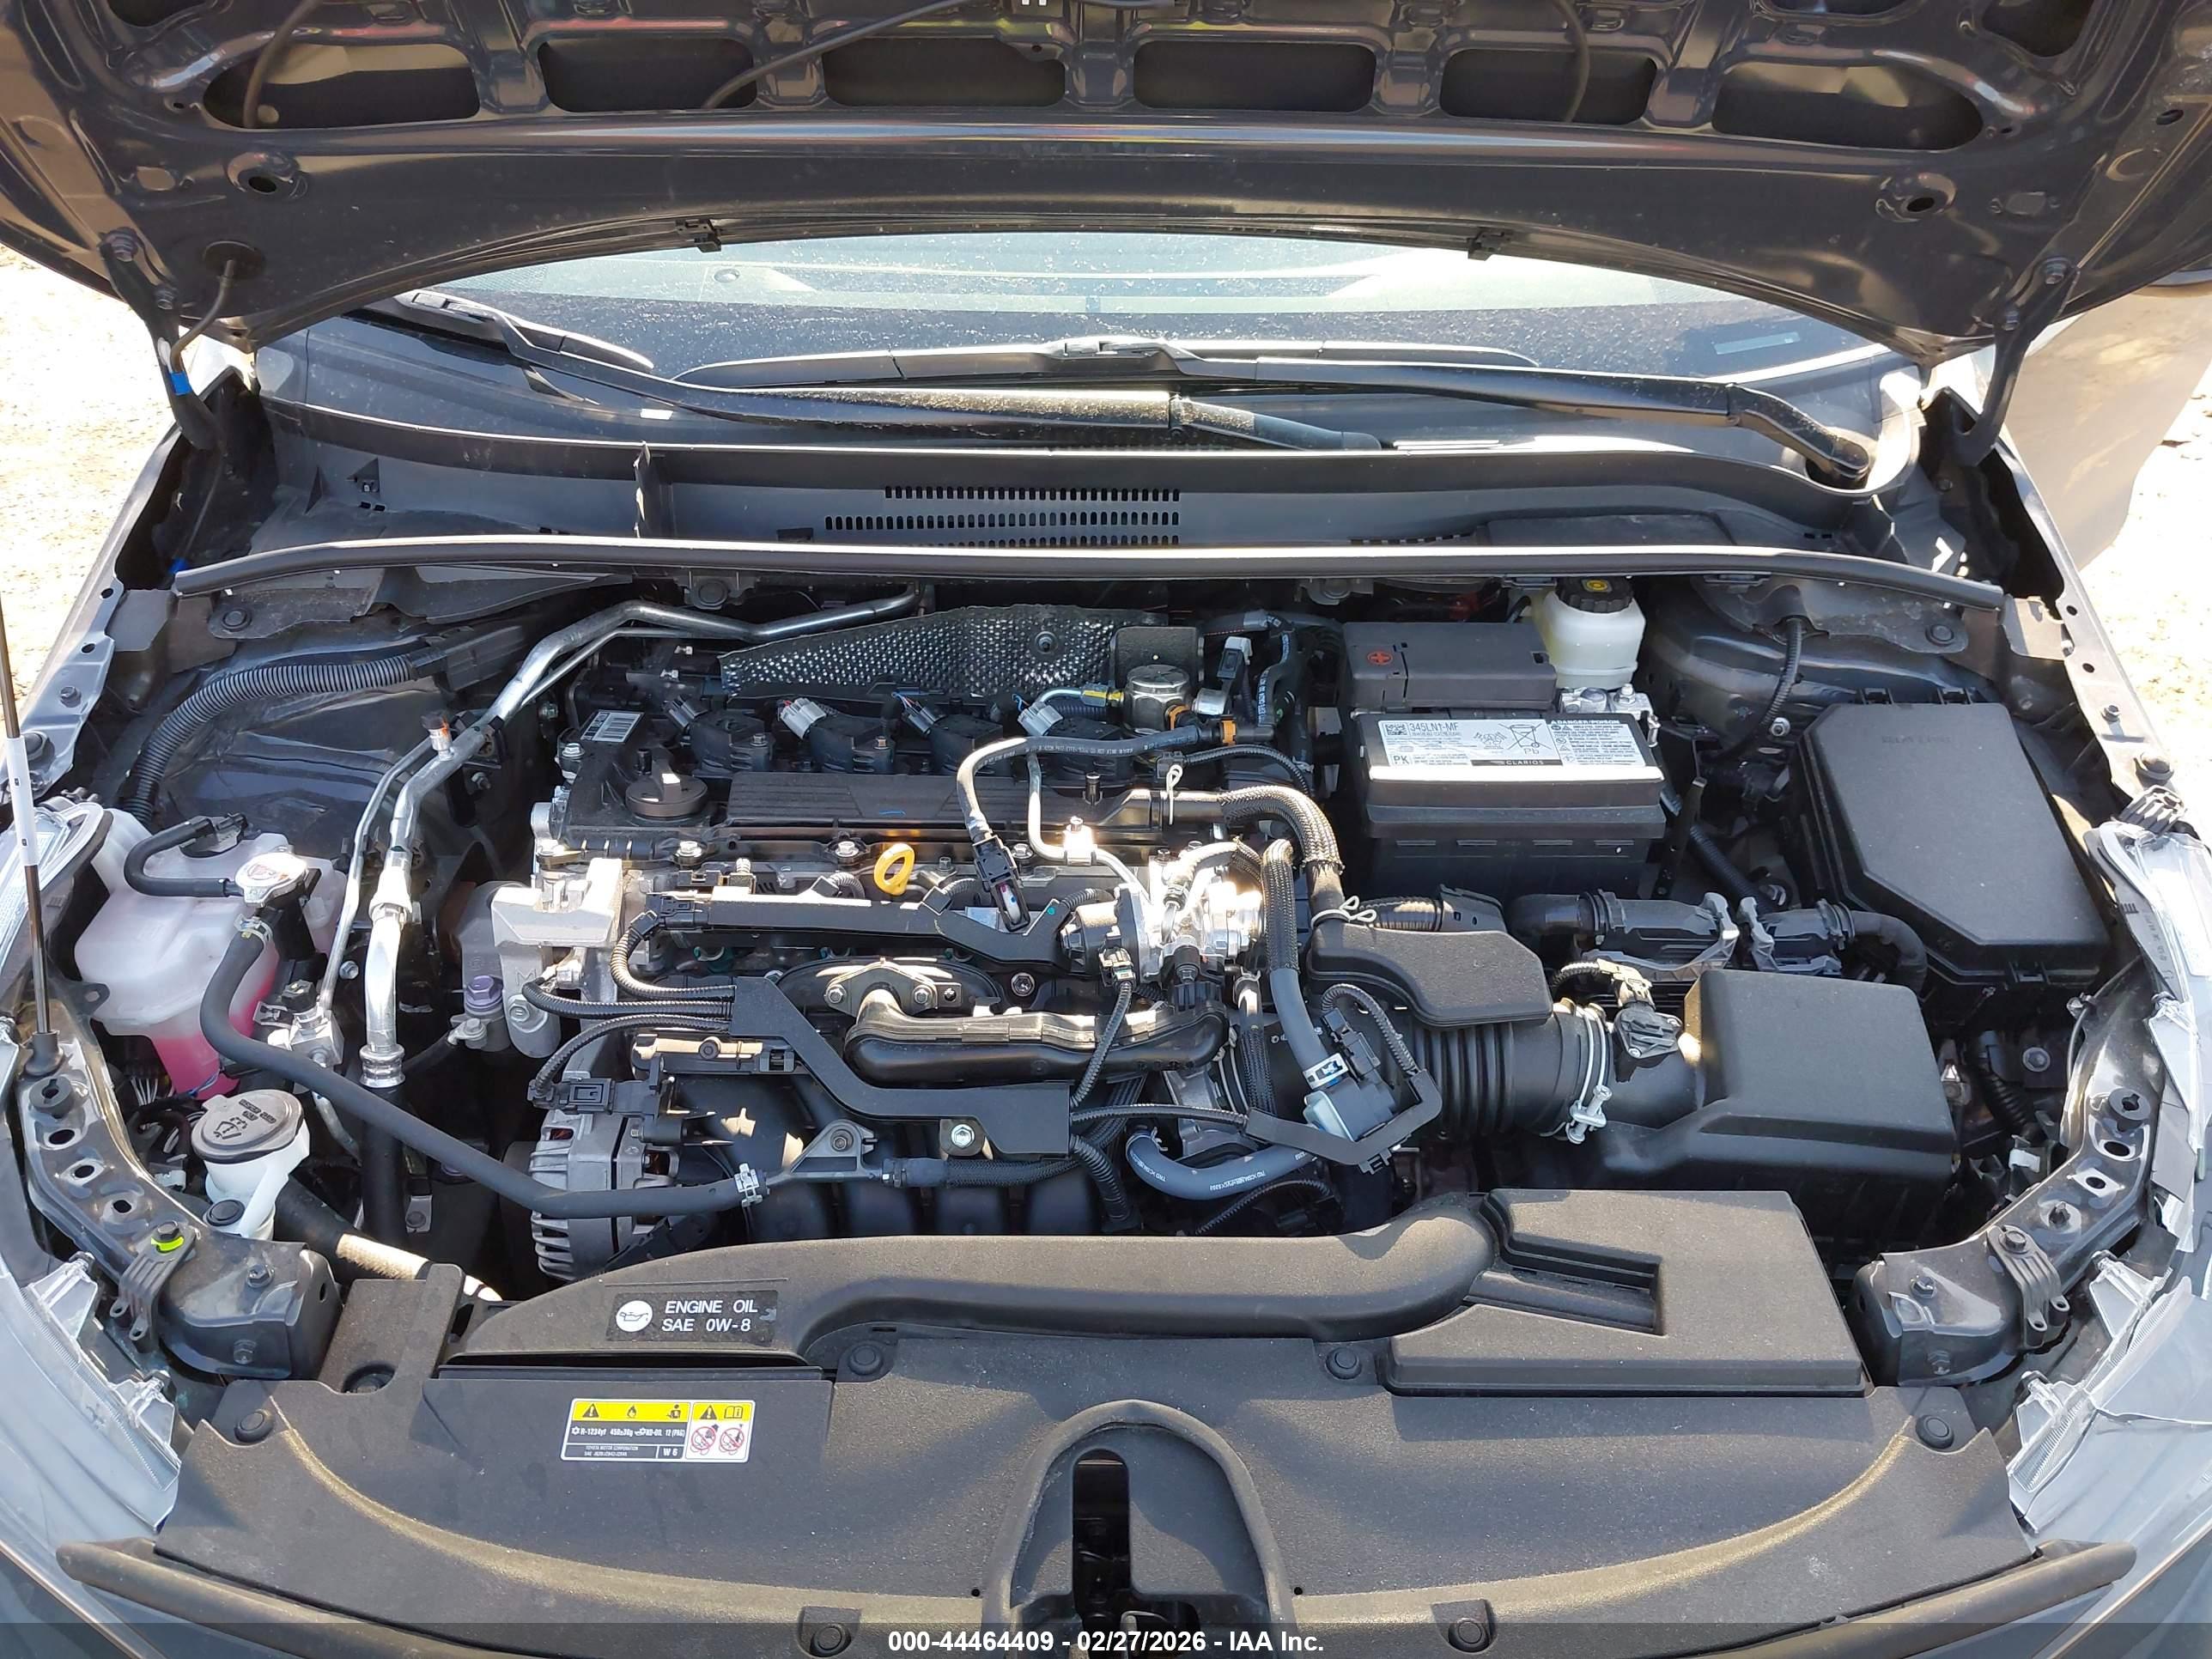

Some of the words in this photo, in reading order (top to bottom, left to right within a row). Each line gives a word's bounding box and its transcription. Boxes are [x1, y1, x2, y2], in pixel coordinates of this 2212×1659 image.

[1409, 722, 1459, 732] 345LN1-MF
[1393, 755, 1410, 764] PK
[665, 1299, 723, 1314] ENGINE
[732, 1299, 758, 1313] OIL
[661, 1318, 695, 1332] SAE
[706, 1318, 751, 1332] 0W-8
[580, 1427, 607, 1437] R-1234yf
[663, 1448, 671, 1456] W
[672, 1448, 678, 1456] 6
